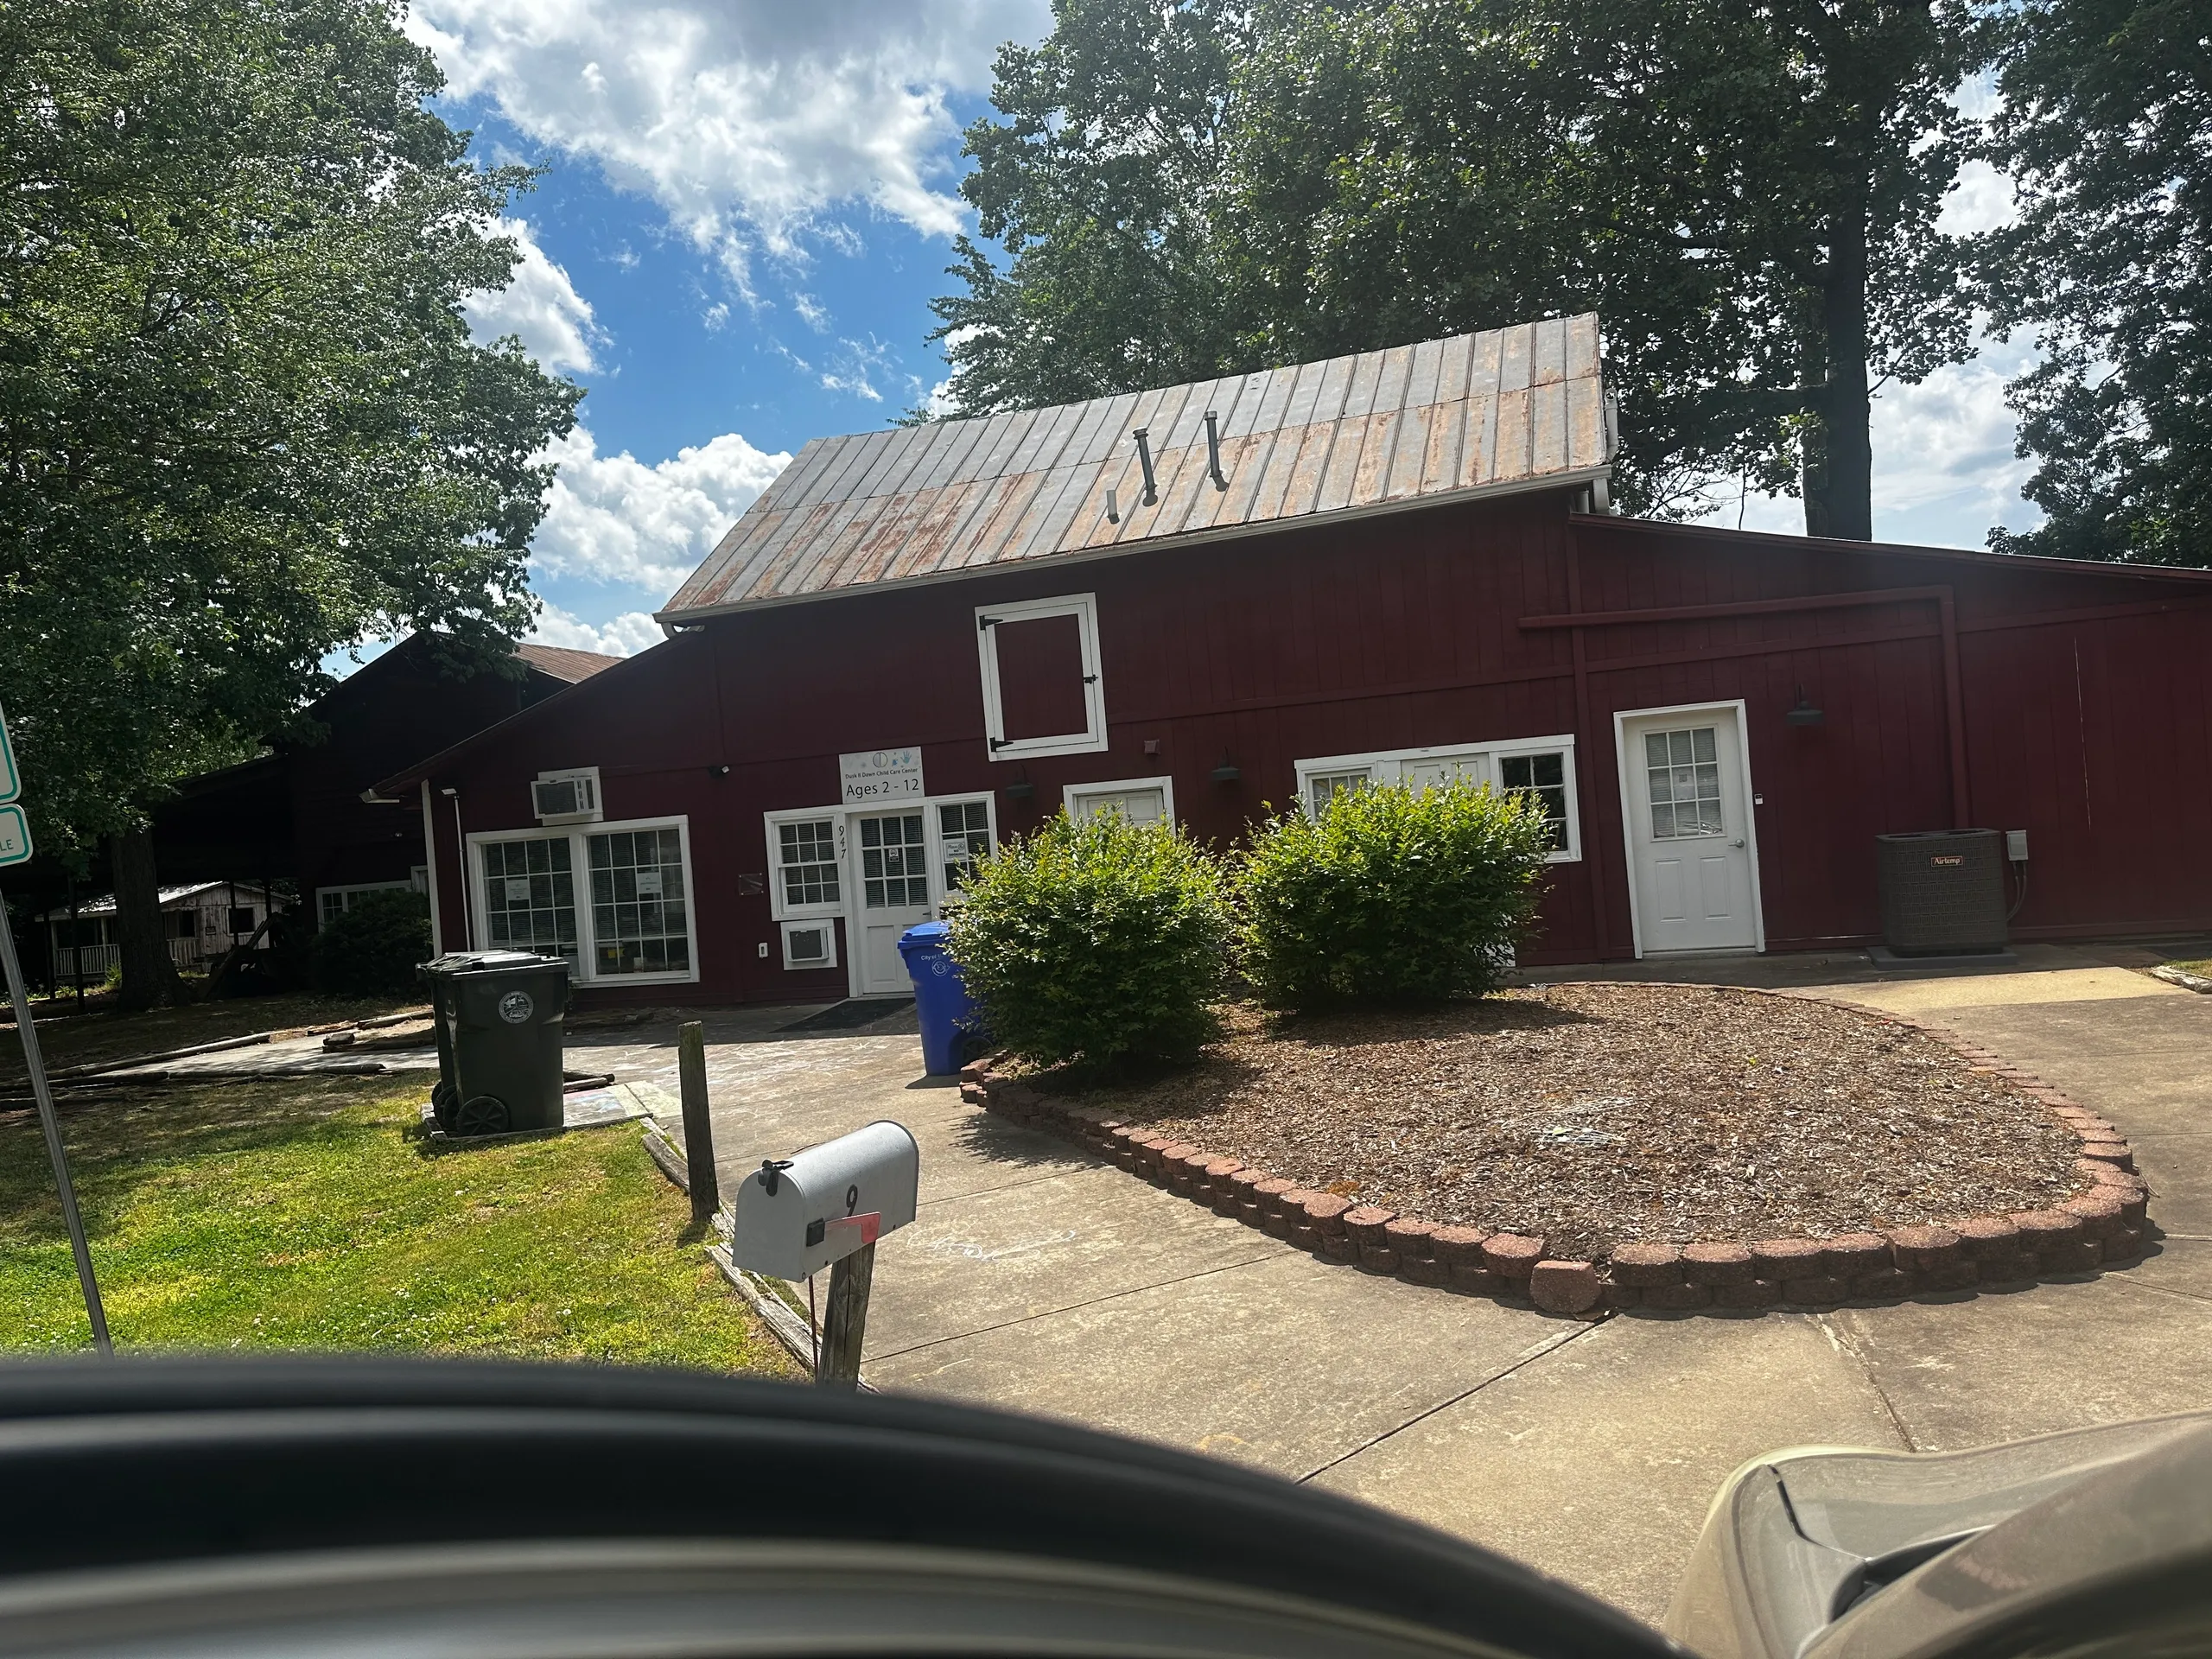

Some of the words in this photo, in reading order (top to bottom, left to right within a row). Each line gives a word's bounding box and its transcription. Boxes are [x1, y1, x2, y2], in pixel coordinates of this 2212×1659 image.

[846, 784, 878, 799] Ages
[881, 781, 890, 793] 2
[903, 779, 919, 791] 12
[838, 825, 847, 859] 947
[846, 1184, 859, 1217] 9
